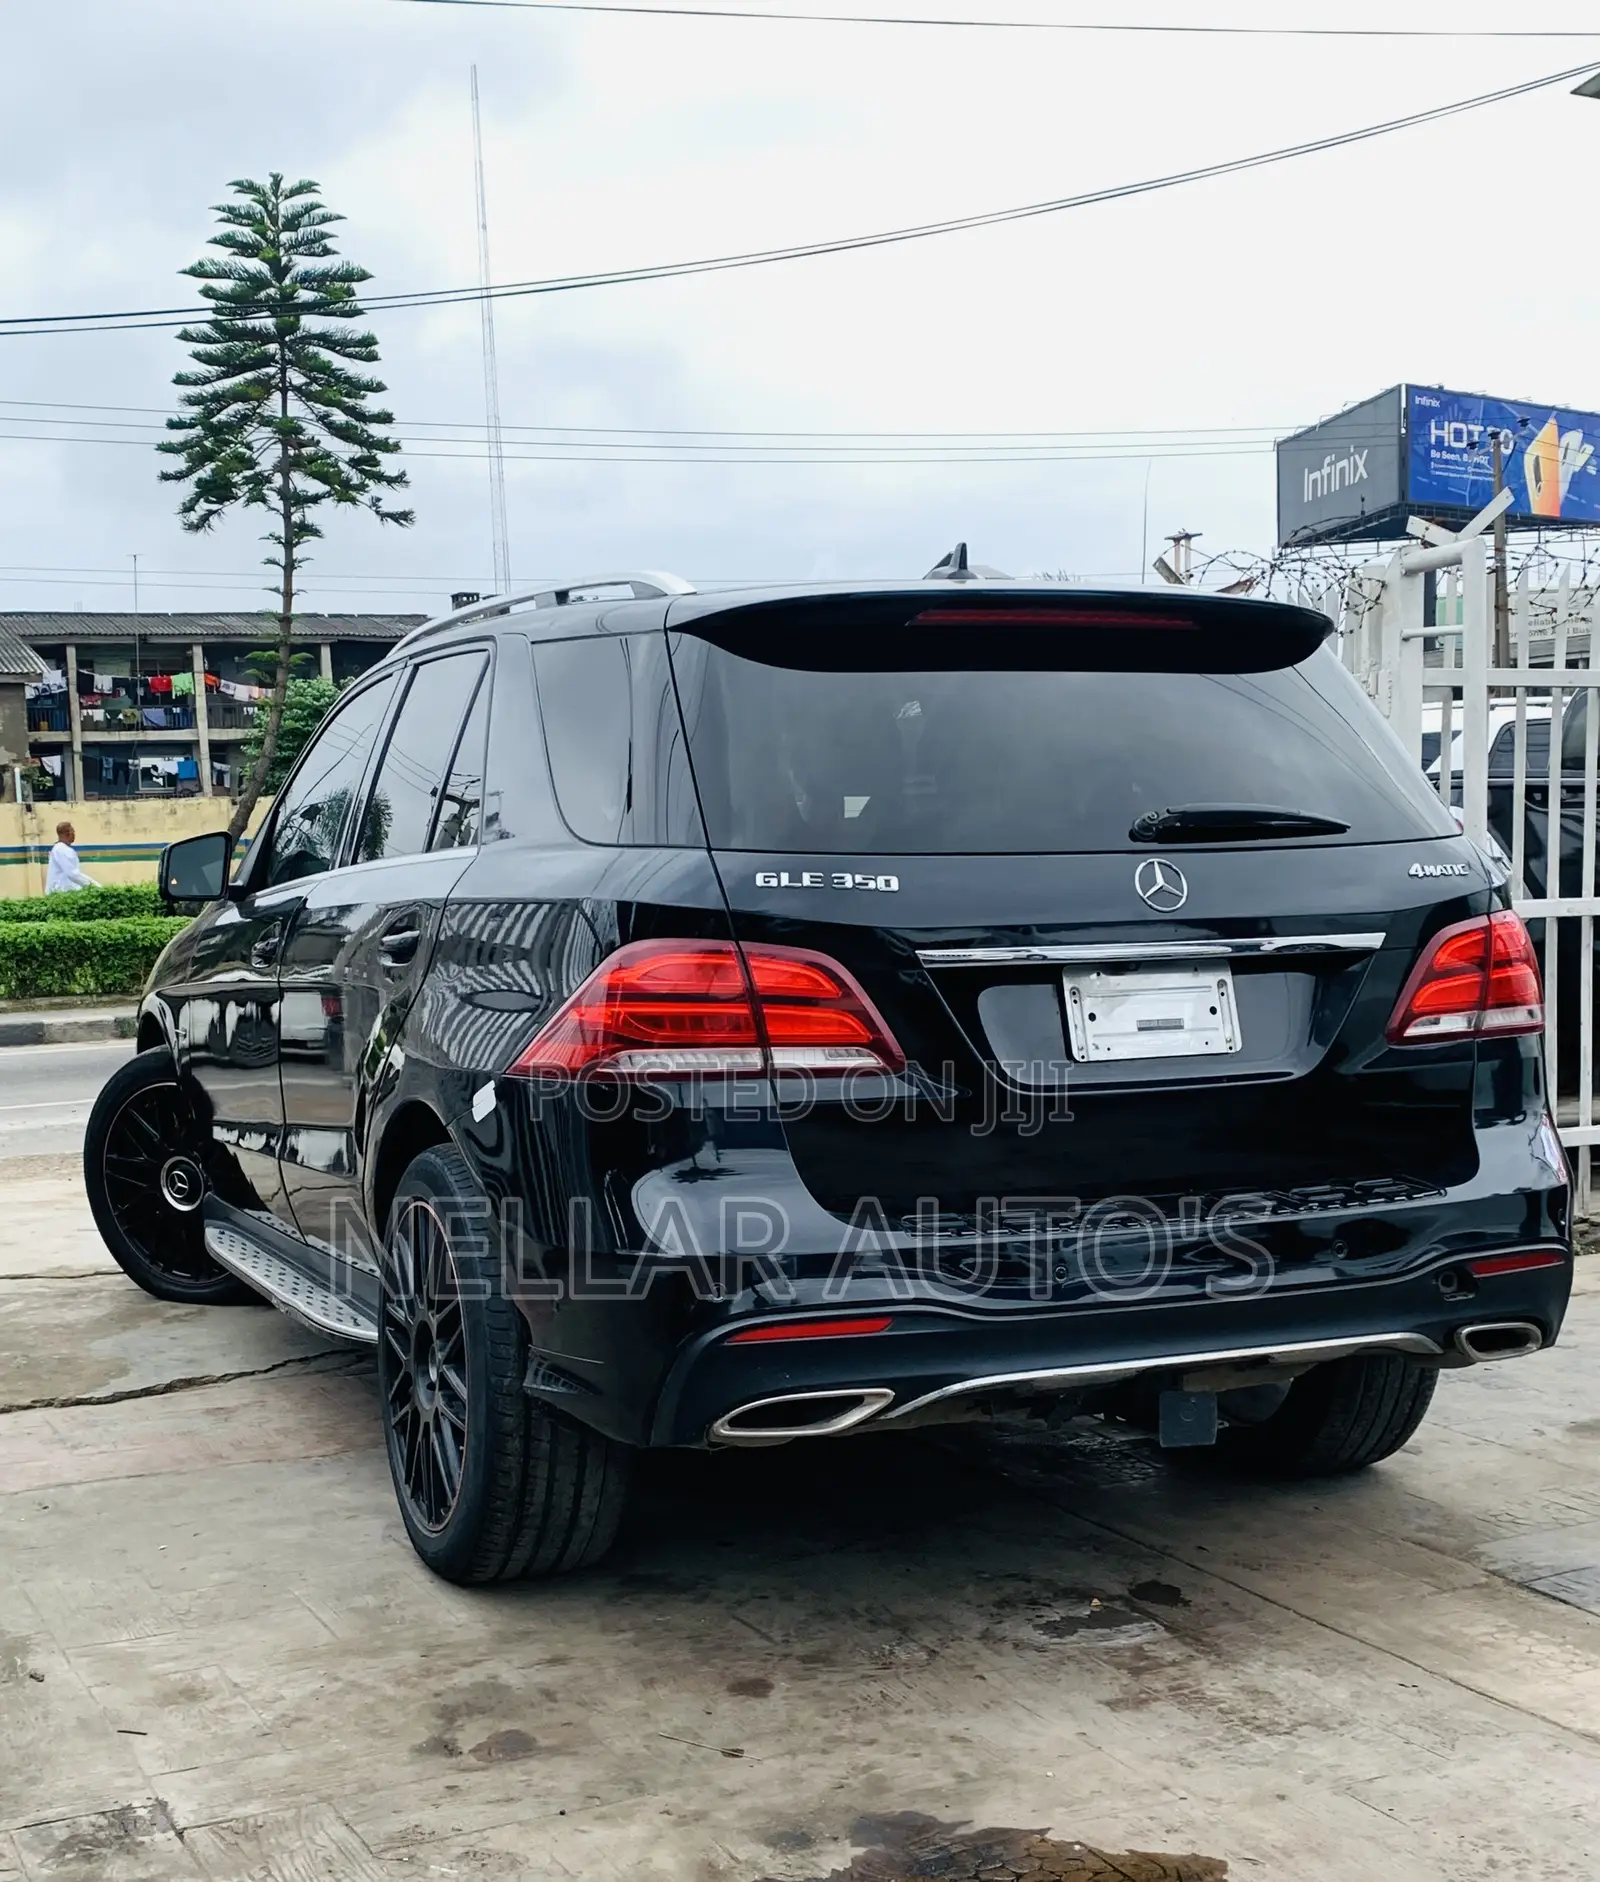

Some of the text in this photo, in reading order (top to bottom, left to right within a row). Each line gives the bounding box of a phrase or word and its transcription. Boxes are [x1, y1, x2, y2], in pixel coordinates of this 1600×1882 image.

[1414, 395, 1440, 408] Infinix
[1430, 419, 1484, 449] HOT
[1430, 449, 1441, 458] Be
[1303, 445, 1369, 503] Infinix
[1408, 862, 1470, 878] 4MATIC
[755, 872, 900, 892] GLE 350
